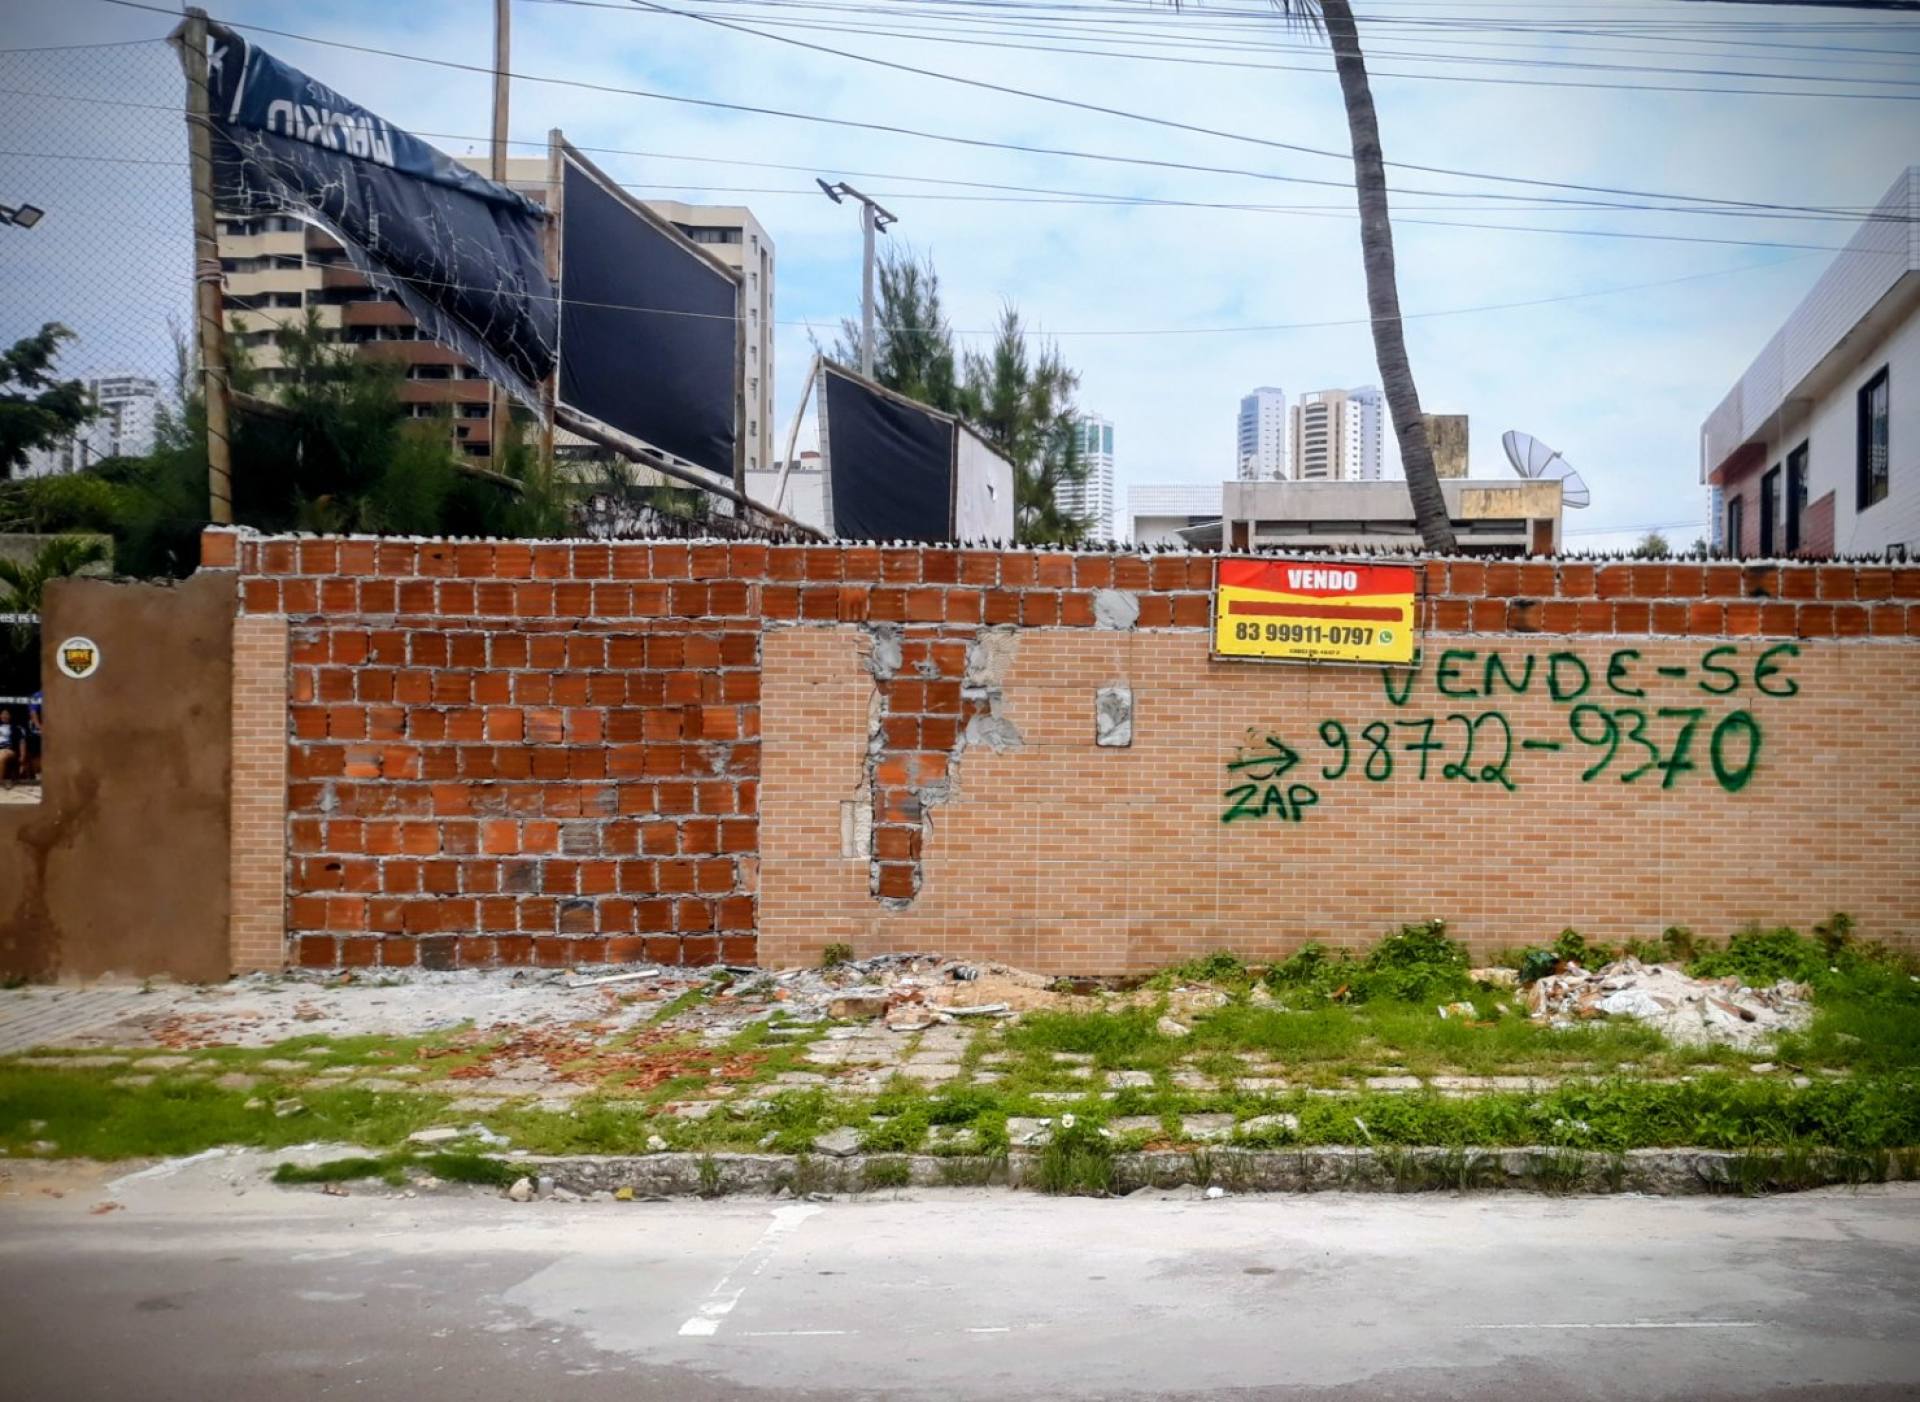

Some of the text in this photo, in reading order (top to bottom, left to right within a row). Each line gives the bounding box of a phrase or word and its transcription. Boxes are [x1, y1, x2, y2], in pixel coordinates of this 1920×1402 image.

[1288, 569, 1358, 591] VENDO
[1235, 622, 1374, 645] 83 99911-0797
[1380, 643, 1801, 706] VENDE-SE
[1318, 703, 1763, 793] 98722-9370
[1222, 784, 1319, 823] ZAP
